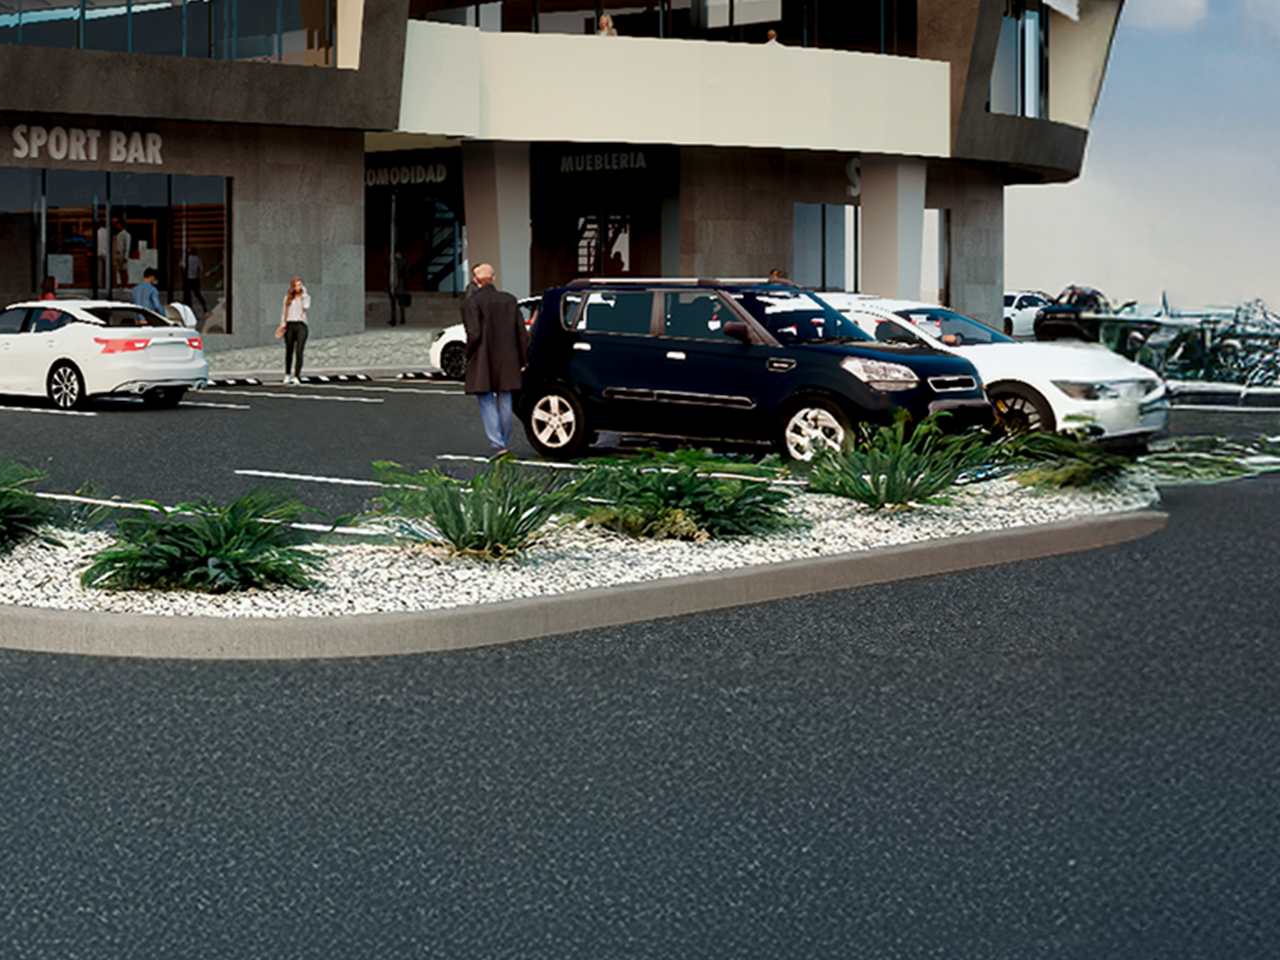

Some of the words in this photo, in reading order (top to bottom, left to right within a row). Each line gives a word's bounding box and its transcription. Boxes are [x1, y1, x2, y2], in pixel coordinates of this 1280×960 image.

[12, 123, 101, 161] SPORT
[109, 129, 163, 165] BAR
[560, 151, 648, 173] MUEBLERIA
[364, 163, 448, 187] OMODIDAD
